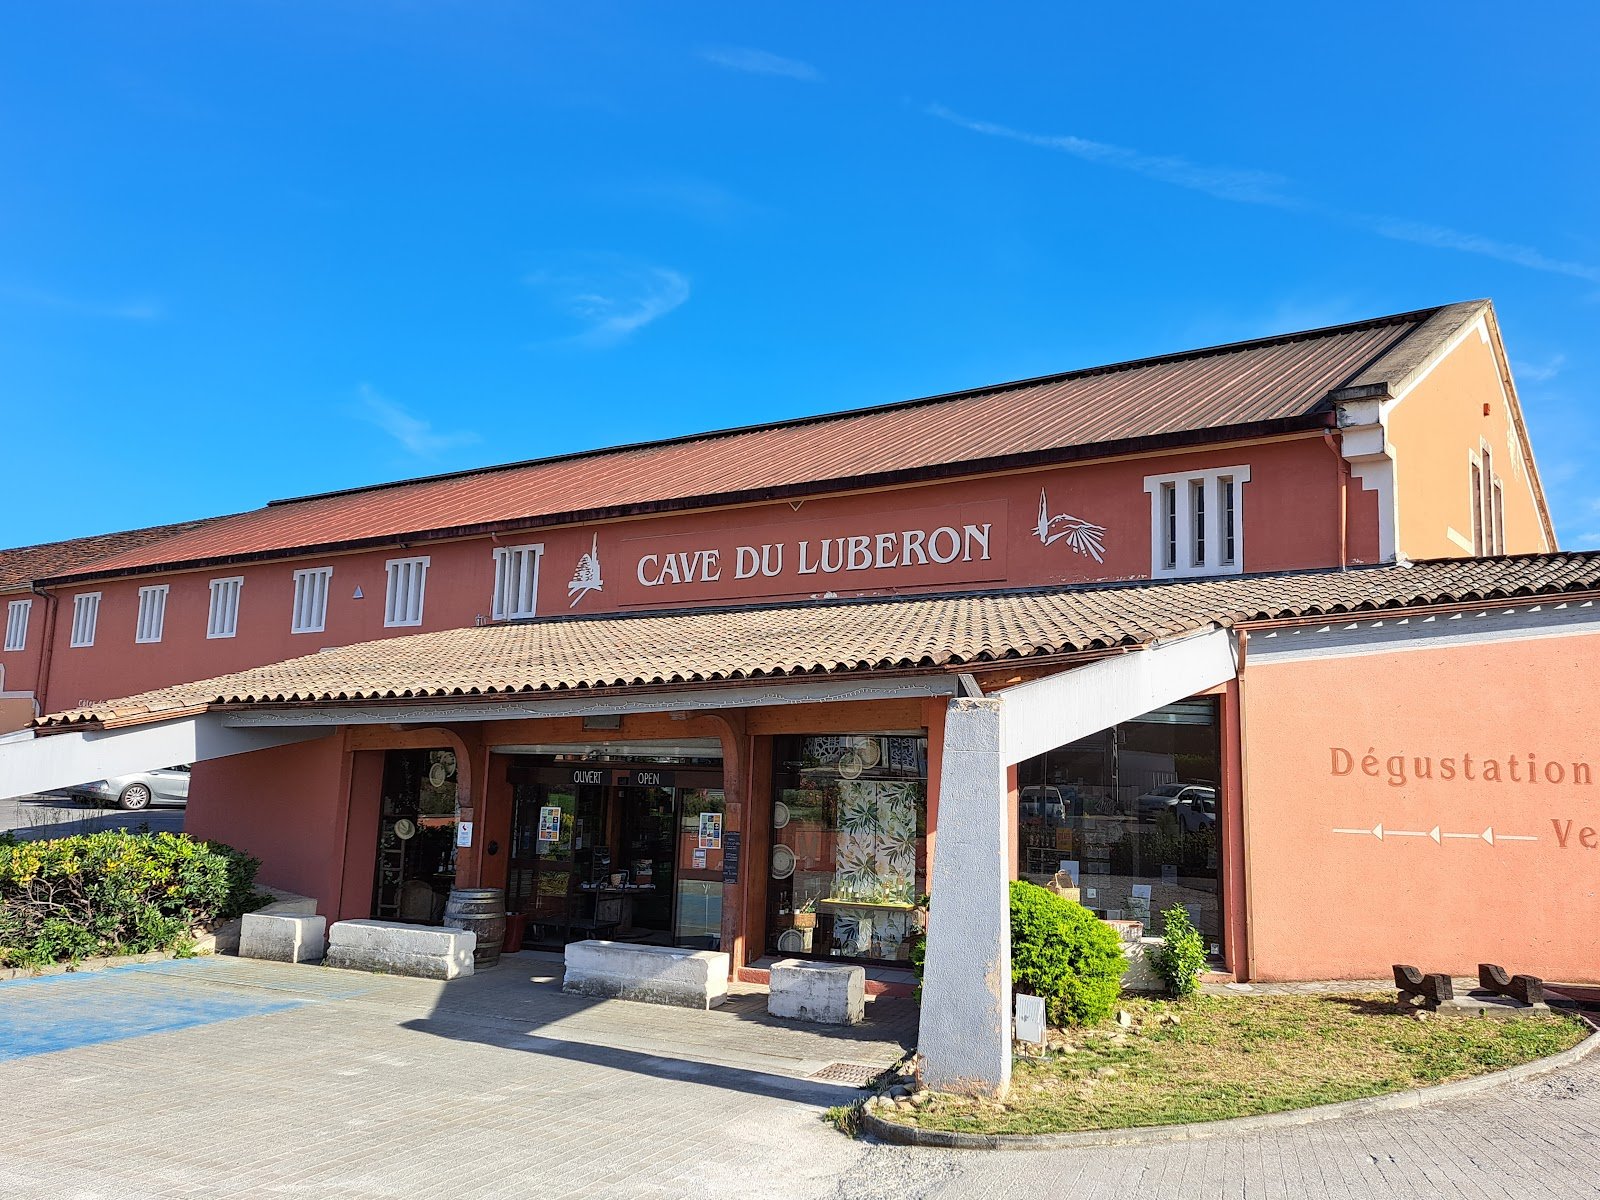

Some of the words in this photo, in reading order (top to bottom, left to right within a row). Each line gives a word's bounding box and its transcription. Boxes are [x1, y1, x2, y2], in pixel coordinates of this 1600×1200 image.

[637, 549, 722, 588] CAVE
[734, 543, 785, 580] DU
[797, 523, 992, 575] LUBERON
[573, 770, 603, 784] OUVERT
[637, 772, 660, 785] OPEN
[1329, 746, 1593, 788] Dégustation
[1550, 818, 1598, 850] Ve
